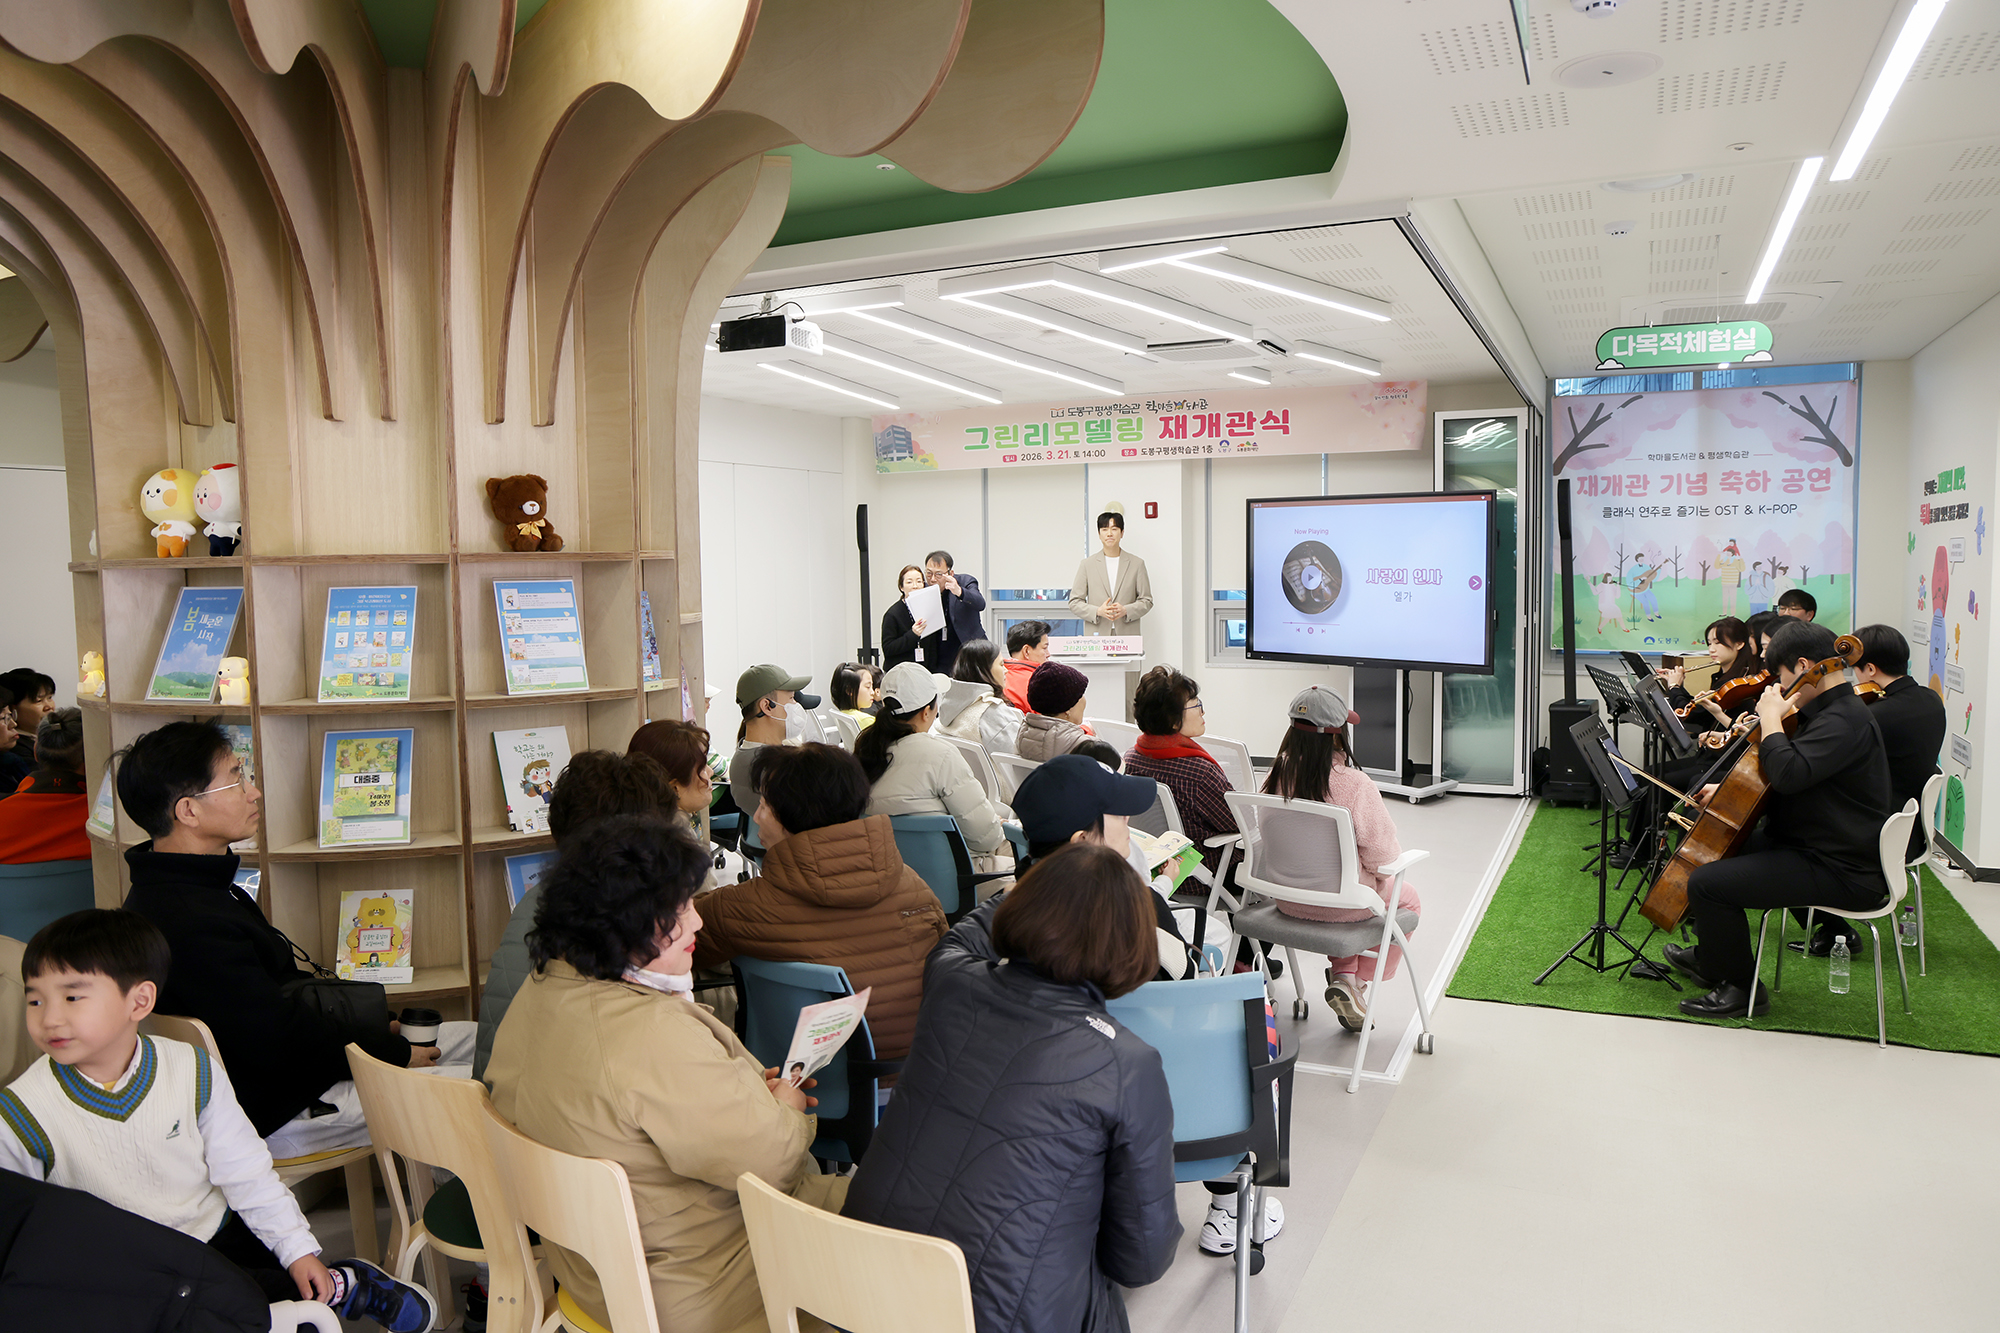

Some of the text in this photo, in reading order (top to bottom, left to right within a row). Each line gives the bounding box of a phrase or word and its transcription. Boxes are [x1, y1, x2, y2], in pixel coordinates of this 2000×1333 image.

[1612, 327, 1757, 357] 다목적체험실
[1067, 403, 1141, 417] 도봉구평생학습관
[963, 408, 1291, 451] 그린리모델링 재개관식
[1021, 453, 1044, 461] 2026.
[1046, 450, 1056, 460] 3.
[1057, 450, 1071, 460] 21.
[1074, 450, 1081, 458] 토
[1082, 450, 1106, 458] 14:00
[1141, 445, 1199, 456] 도봉구평생학습관
[1202, 445, 1214, 453] 1층
[1648, 450, 1750, 462] 학마을도서관 & 평생학습관
[1576, 466, 1832, 498] 재개관 기념 축하 공연
[1602, 503, 1798, 519] 클래식 연주로 즐기는 OST & K-POP
[1308, 527, 1329, 536] Playing
[1366, 568, 1443, 585] 사랑의 인사
[199, 614, 224, 628] 새로운
[197, 629, 214, 642] 시작
